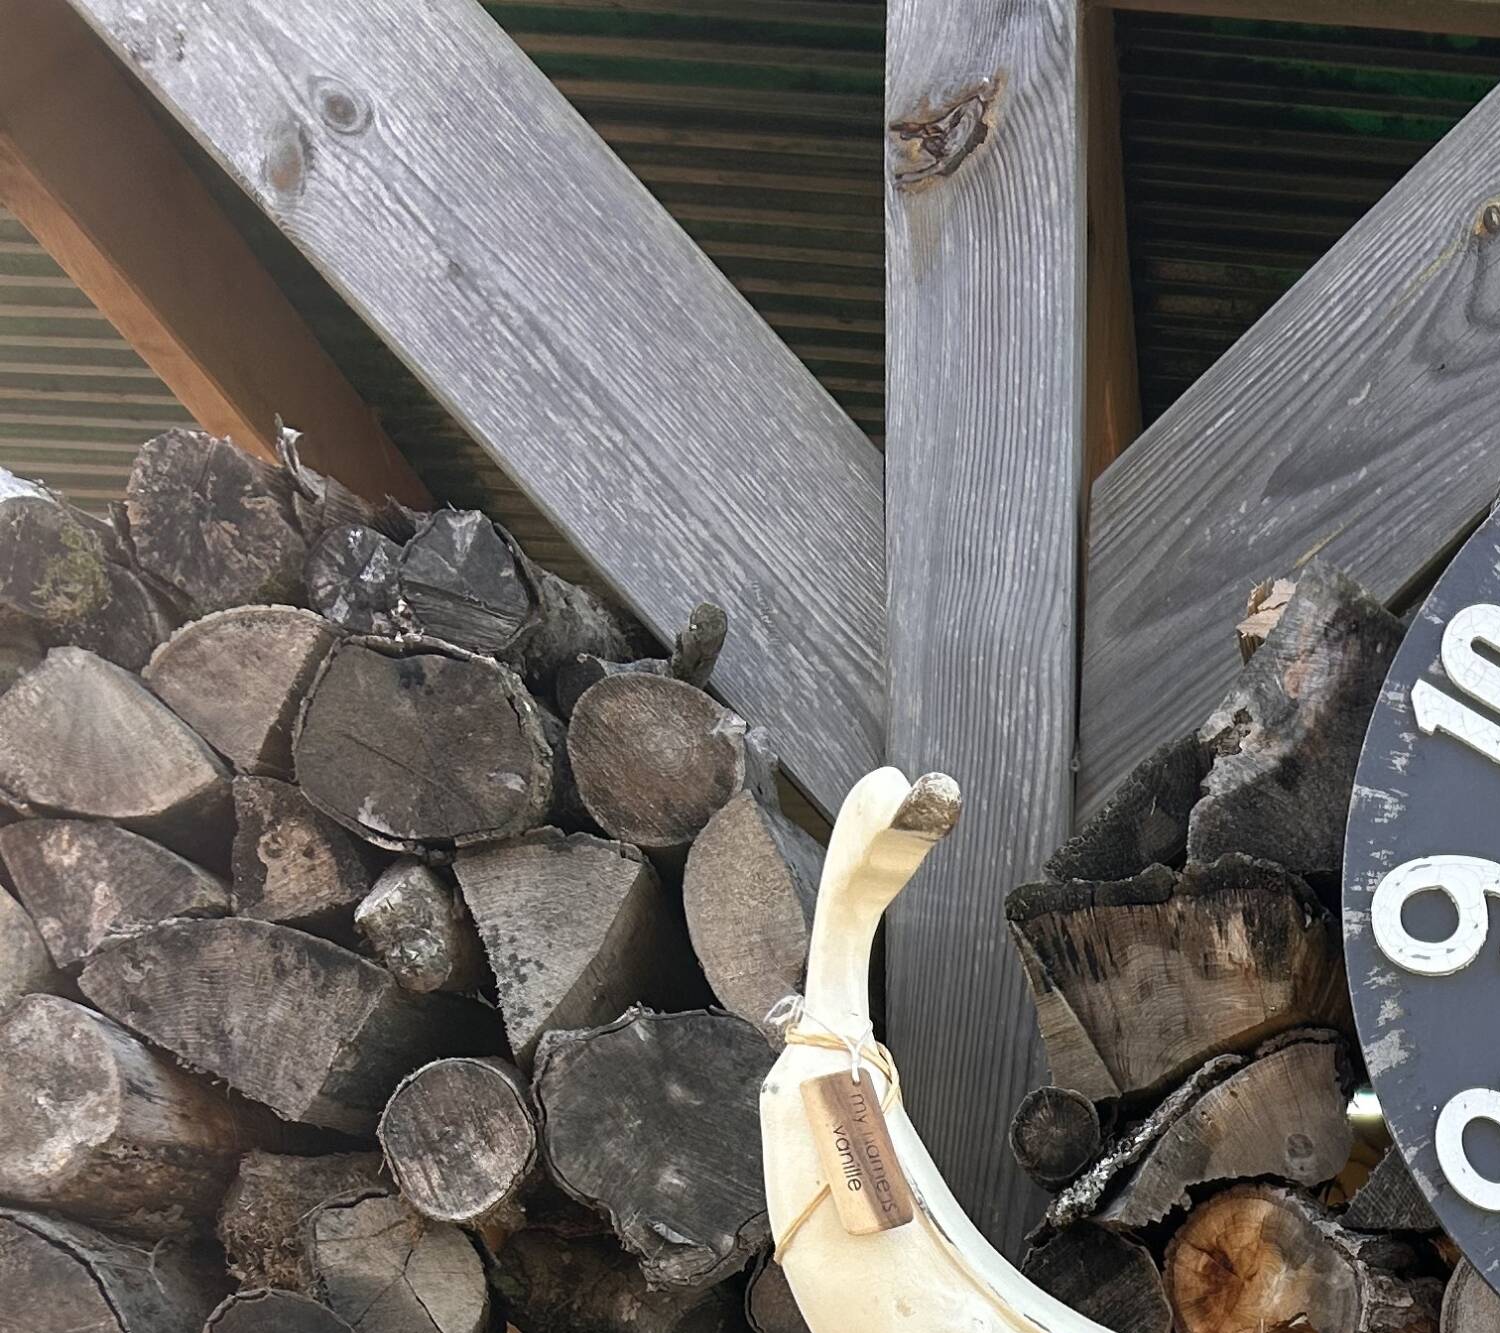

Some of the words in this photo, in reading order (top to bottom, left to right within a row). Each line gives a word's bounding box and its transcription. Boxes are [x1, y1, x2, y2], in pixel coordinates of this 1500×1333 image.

[833, 1125, 863, 1192] vanille
[851, 1092, 867, 1124] my
[864, 1131, 891, 1193] name
[881, 1198, 898, 1213] is
